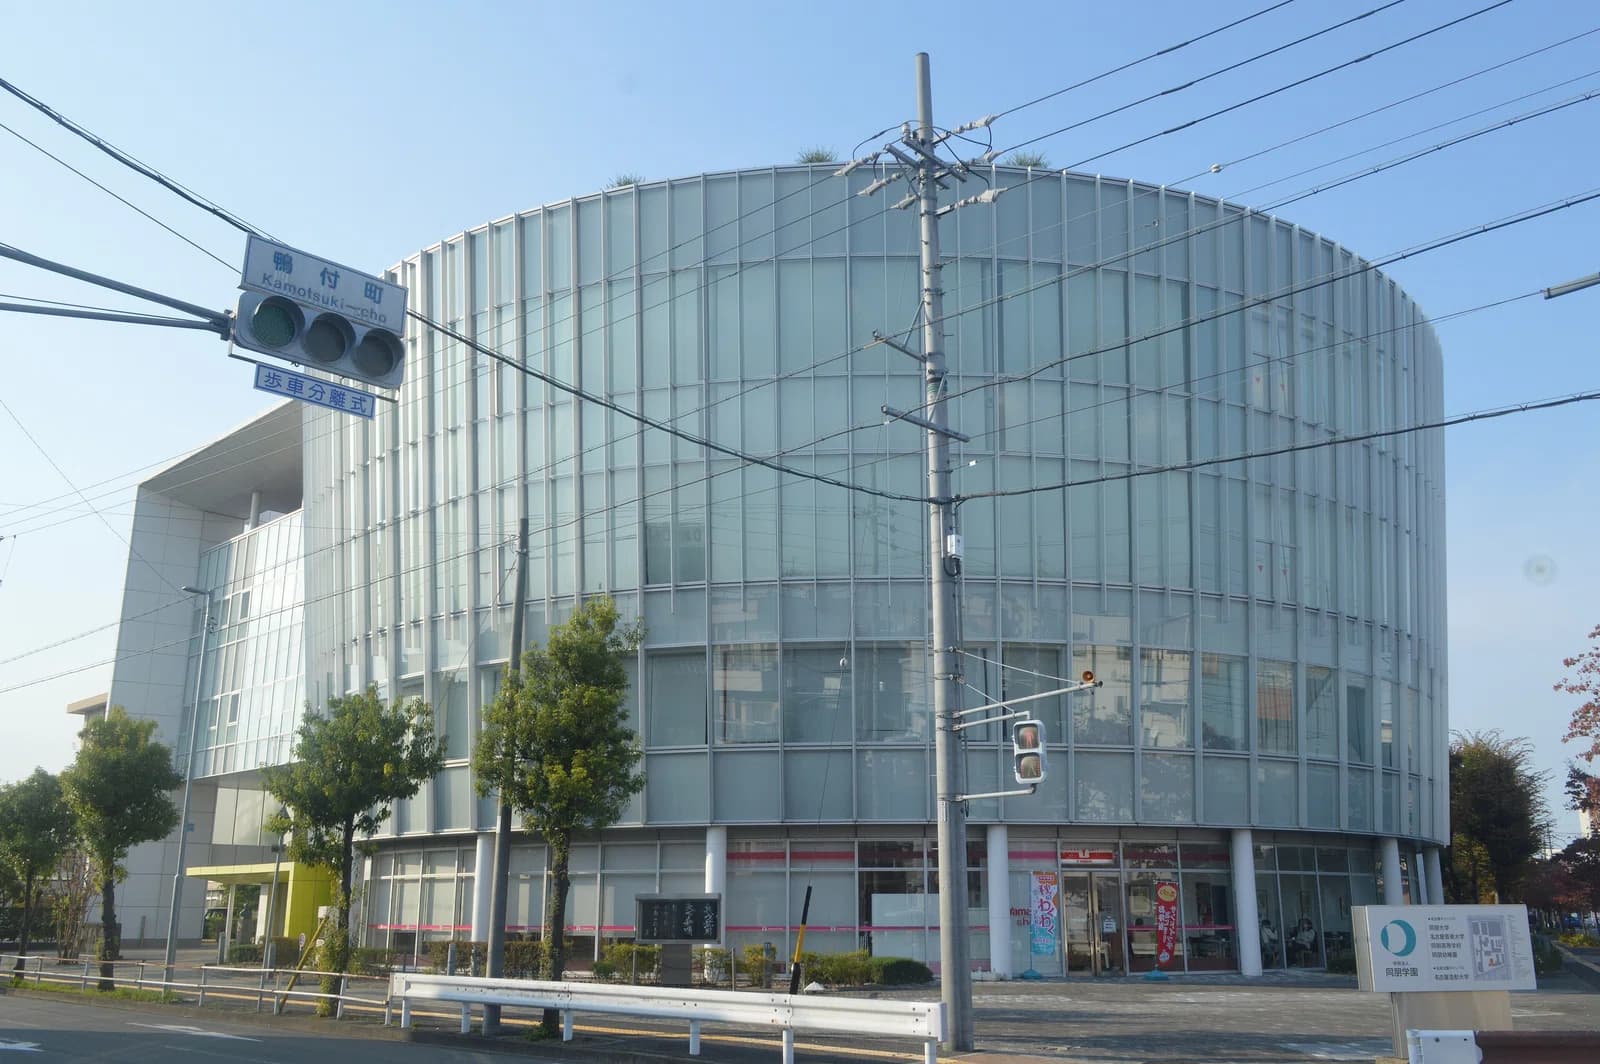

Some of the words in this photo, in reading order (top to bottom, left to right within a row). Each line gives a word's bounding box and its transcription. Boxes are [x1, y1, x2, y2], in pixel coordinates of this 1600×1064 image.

[274, 252, 383, 304] 鴨付町
[264, 372, 367, 413] 歩車分離式
